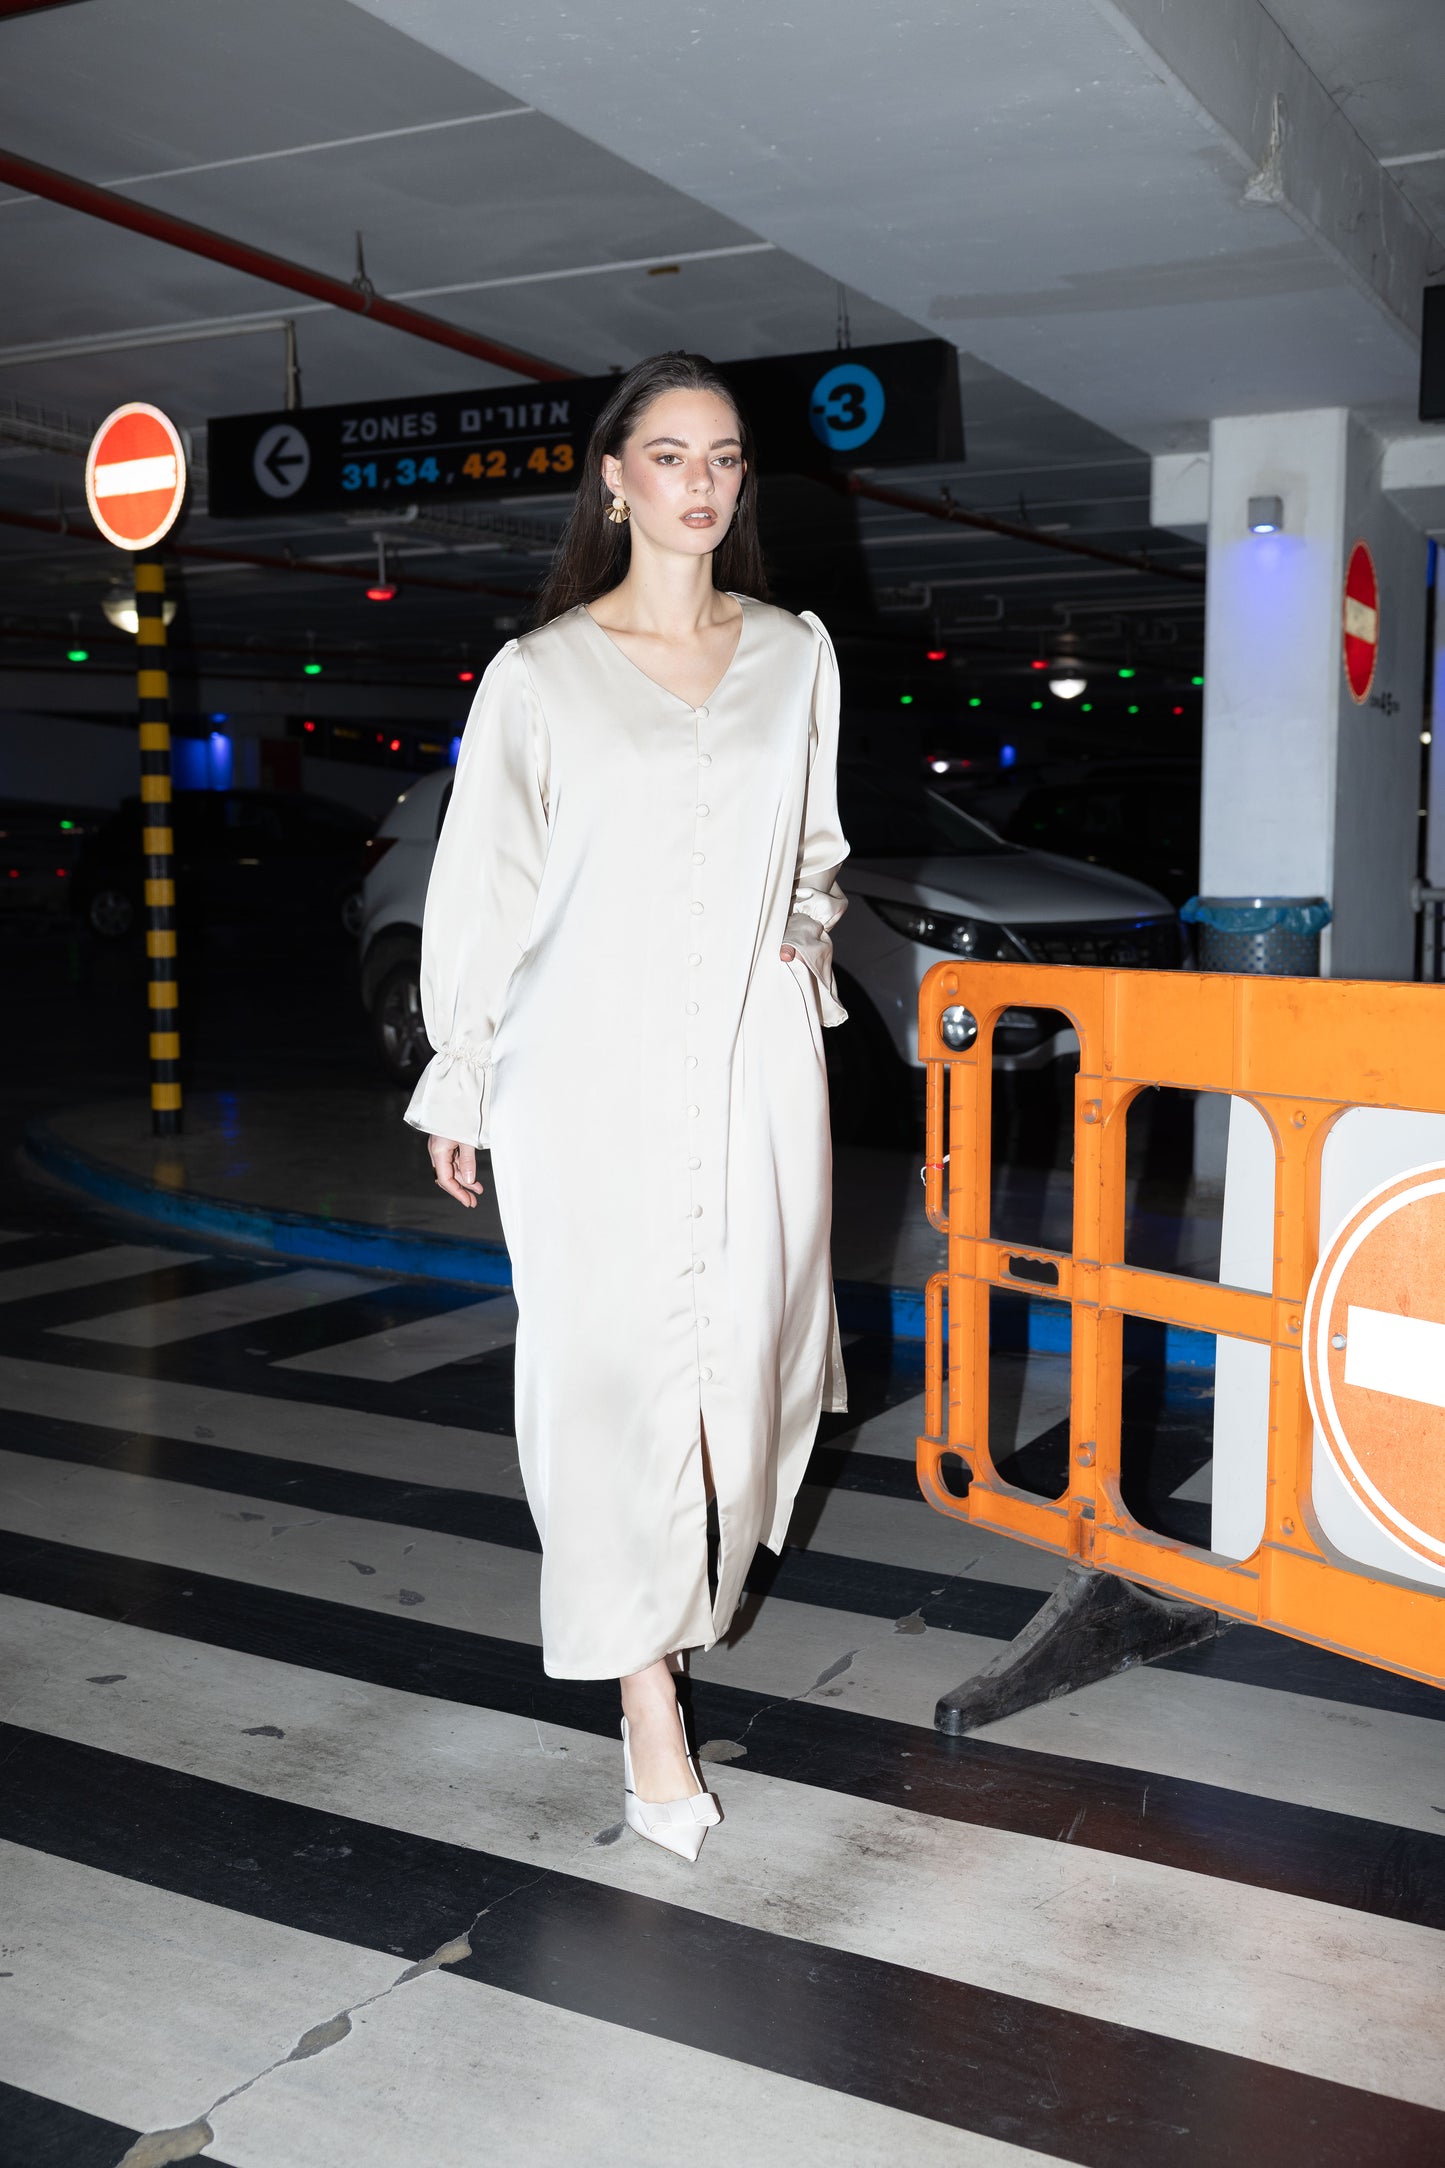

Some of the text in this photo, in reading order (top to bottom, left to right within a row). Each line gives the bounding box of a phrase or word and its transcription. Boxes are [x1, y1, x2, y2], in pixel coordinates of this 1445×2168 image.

[459, 400, 571, 433] אזורים
[812, 382, 867, 432] -3
[341, 411, 438, 444] ZONES
[527, 443, 575, 474] 43
